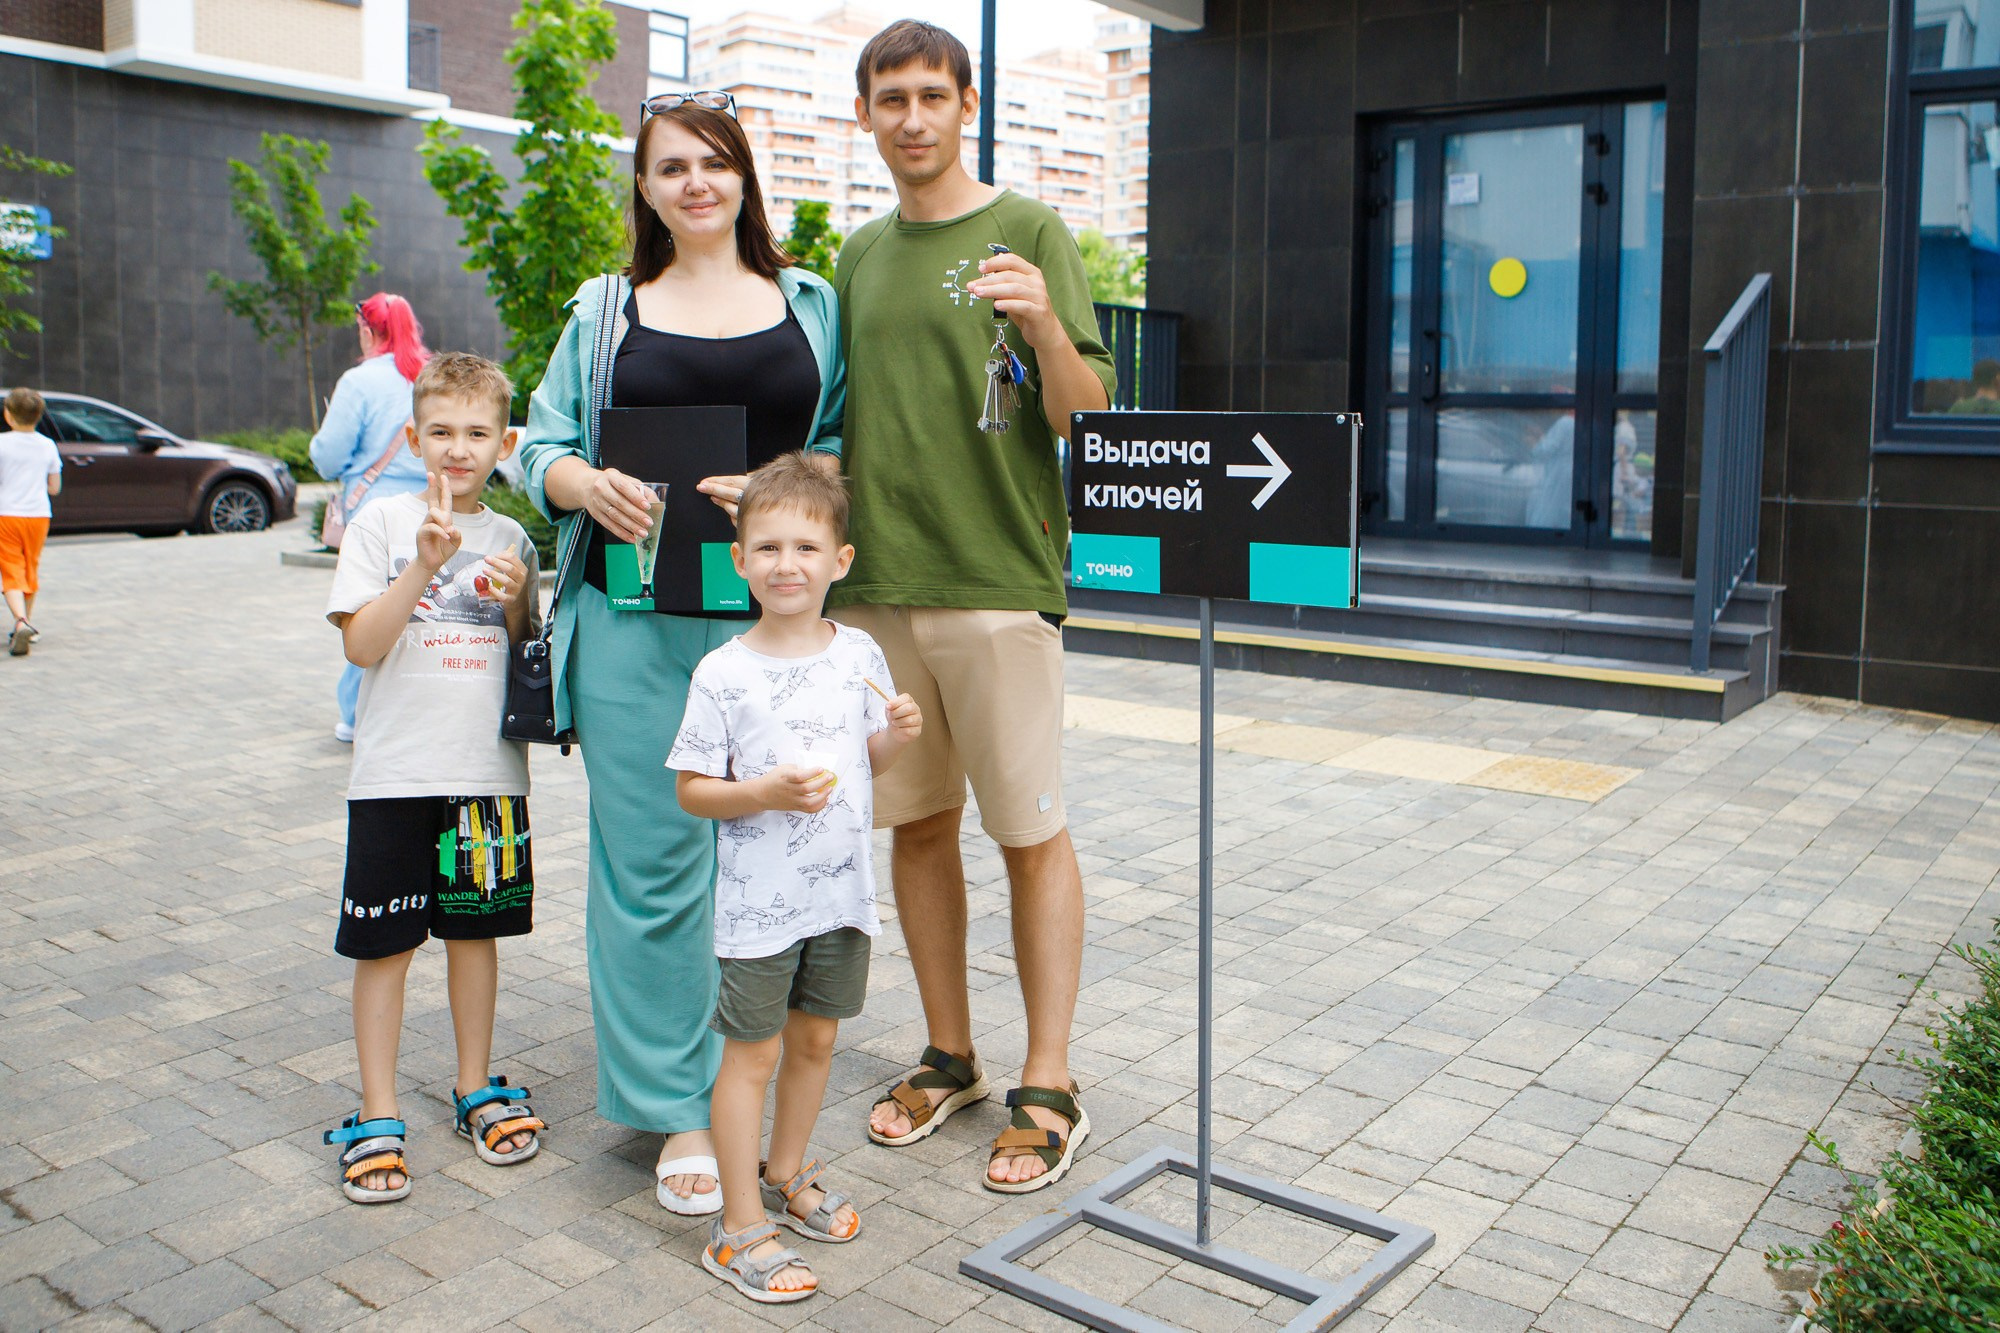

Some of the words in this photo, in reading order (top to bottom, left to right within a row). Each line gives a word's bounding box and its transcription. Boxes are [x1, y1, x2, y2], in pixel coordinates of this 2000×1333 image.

[1084, 432, 1211, 468] Выдача
[1084, 478, 1203, 511] ключей
[423, 633, 464, 648] wild
[469, 633, 500, 646] soul
[442, 657, 462, 669] FREE
[464, 658, 488, 671] SPIRIT
[463, 840, 493, 851] New
[497, 833, 526, 848] City
[438, 891, 480, 901] WANDER
[494, 882, 534, 900] CAPTURE
[344, 896, 384, 918] New
[388, 894, 428, 913] City
